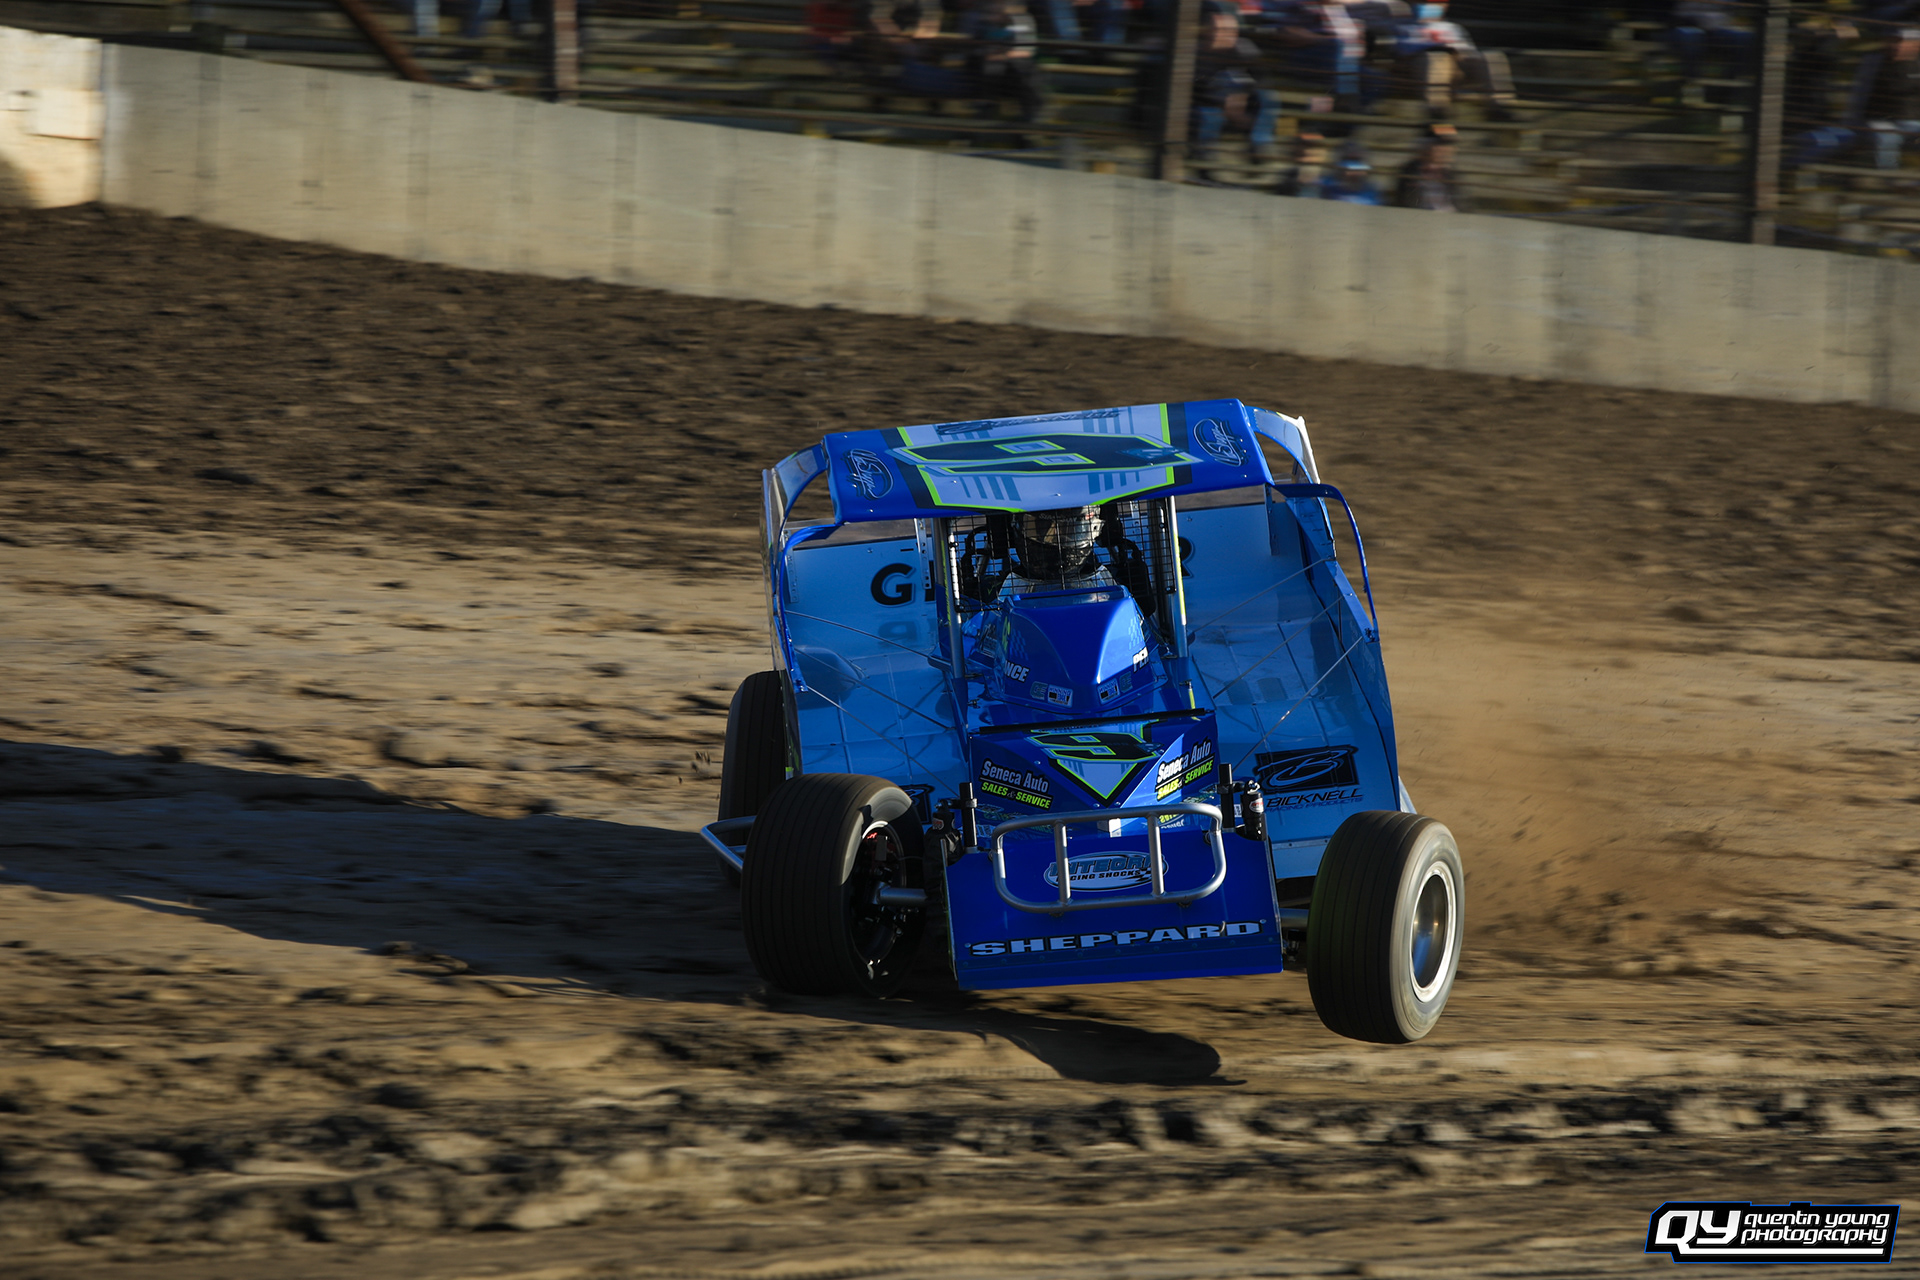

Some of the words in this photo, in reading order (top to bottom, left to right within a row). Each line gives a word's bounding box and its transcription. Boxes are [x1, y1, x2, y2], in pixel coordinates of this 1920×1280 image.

[981, 760, 1022, 786] Seneca
[1023, 772, 1049, 793] Auto
[1157, 753, 1189, 783] Seneca
[1190, 741, 1211, 764] Auto
[981, 781, 1009, 796] SALES
[1015, 792, 1051, 809] SERVICE
[1157, 779, 1180, 800] SALES
[1184, 760, 1214, 783] SERVICE
[1266, 788, 1363, 808] BICKNELL
[1098, 869, 1140, 879] SHOCKS
[971, 921, 1262, 956] SHEPPARD
